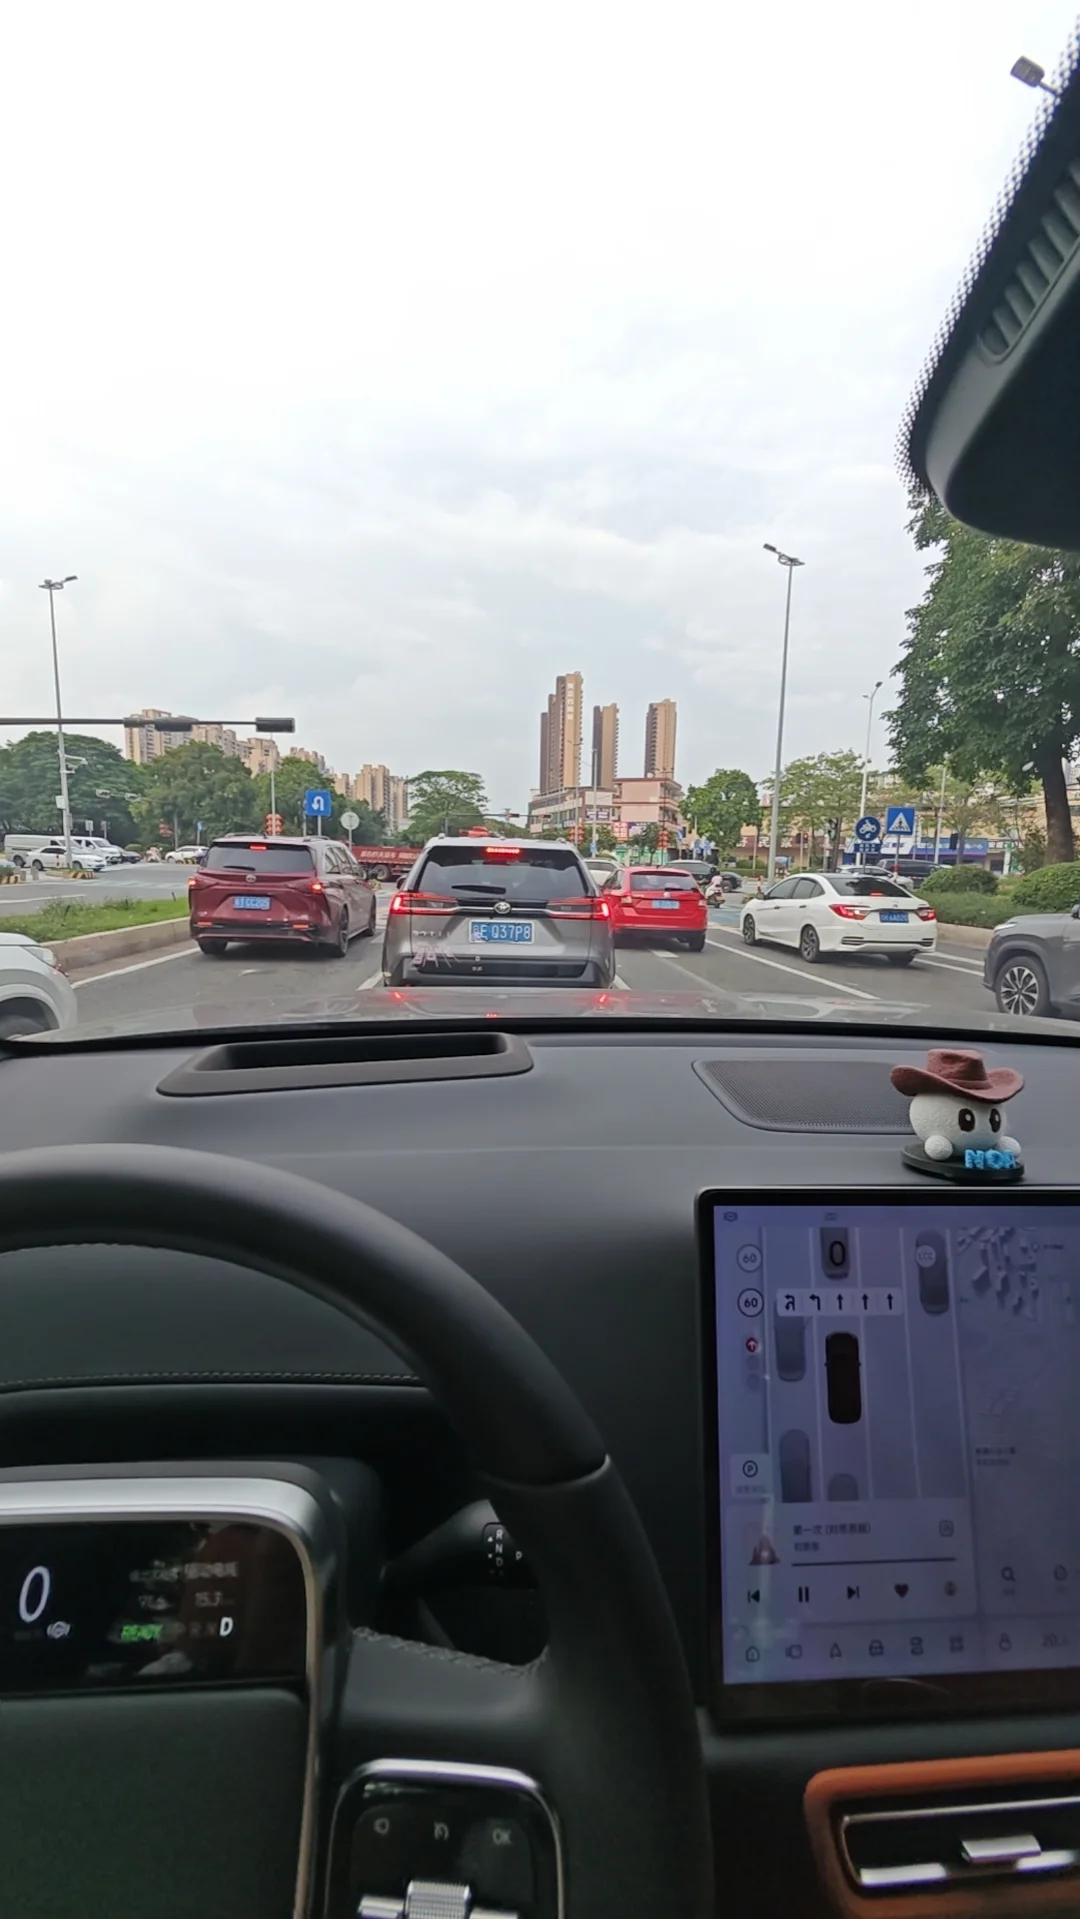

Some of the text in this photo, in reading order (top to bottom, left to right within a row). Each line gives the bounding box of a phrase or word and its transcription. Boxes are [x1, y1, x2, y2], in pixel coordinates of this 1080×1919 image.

[491, 924, 531, 940] Q37P8
[742, 1253, 757, 1264] 60
[828, 1240, 846, 1267] 0
[744, 1297, 758, 1308] 60
[496, 1529, 503, 1540] R
[495, 1543, 503, 1554] N
[515, 1551, 523, 1561] P
[18, 1565, 50, 1623] 0
[219, 1616, 234, 1637] D
[492, 1827, 511, 1845] OK
